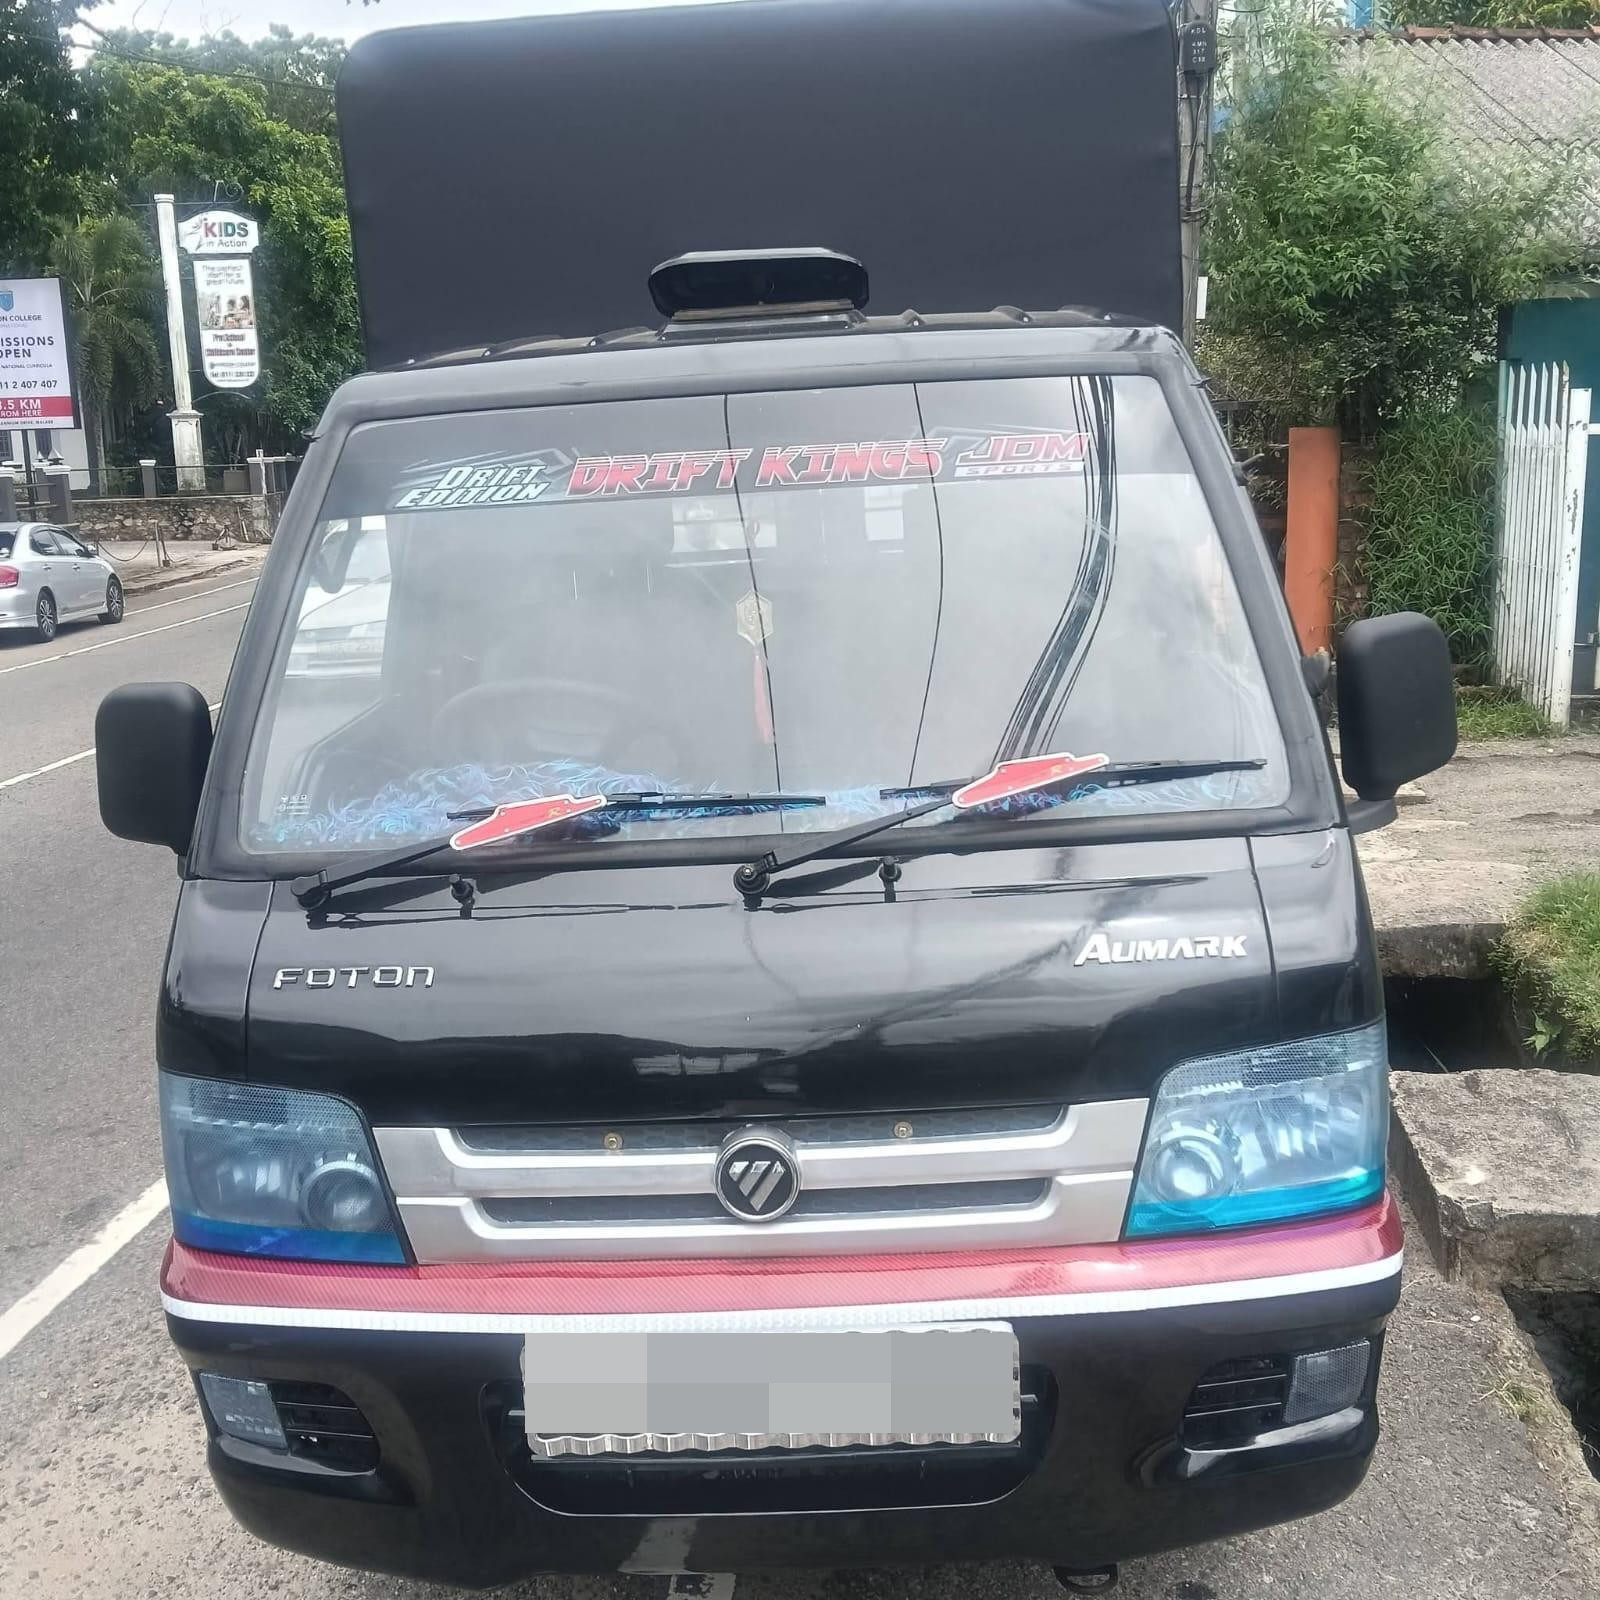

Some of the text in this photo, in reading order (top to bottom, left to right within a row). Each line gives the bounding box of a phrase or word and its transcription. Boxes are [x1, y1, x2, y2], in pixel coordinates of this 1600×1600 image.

[204, 221, 248, 238] KIDS
[206, 239, 248, 248] in Action
[9, 314, 42, 322] COLLEGE
[12, 381, 18, 389] 2
[21, 380, 38, 389] 407
[40, 379, 58, 389] 407
[20, 398, 42, 410] KM
[21, 409, 43, 417] HERE
[955, 432, 1091, 466] JDM
[566, 437, 948, 497] DRIFT KINGS
[965, 461, 1073, 476] SPORTS
[435, 463, 546, 490] DRIFT
[393, 480, 551, 509] EDITION
[1073, 933, 1249, 968] AUMARK
[273, 966, 436, 990] FOTON
